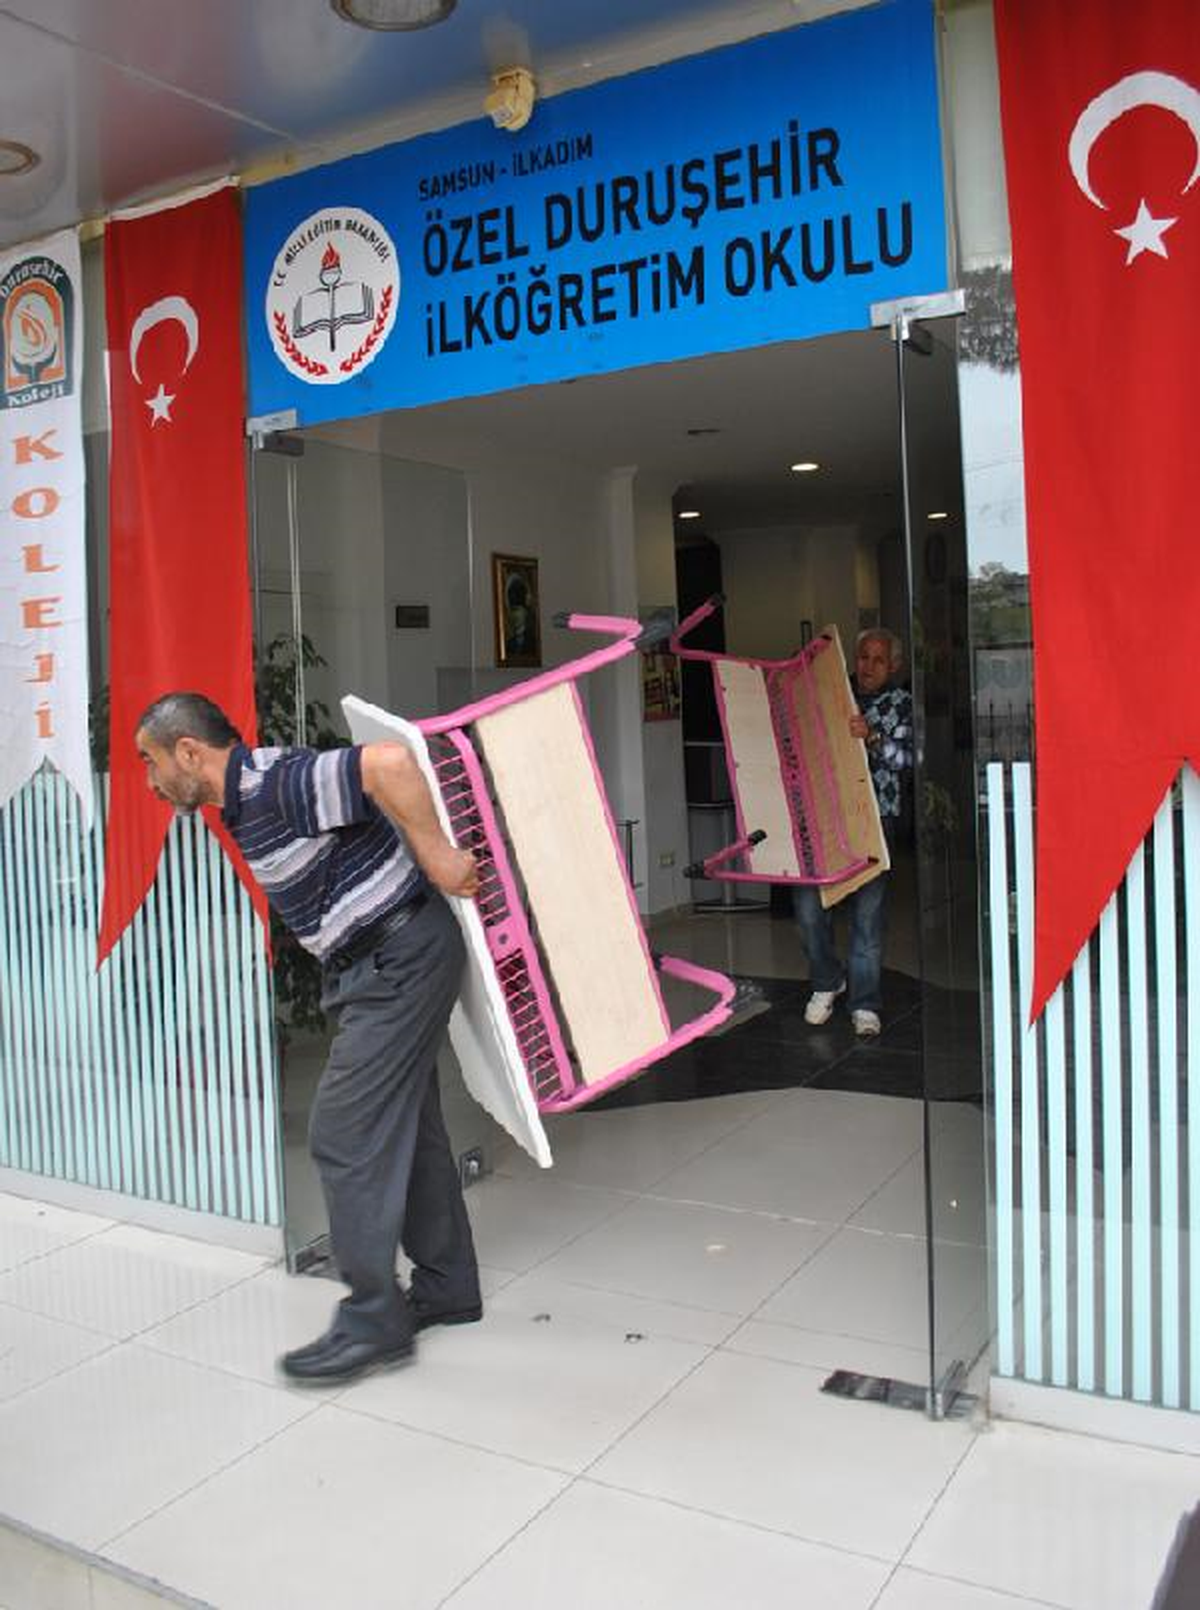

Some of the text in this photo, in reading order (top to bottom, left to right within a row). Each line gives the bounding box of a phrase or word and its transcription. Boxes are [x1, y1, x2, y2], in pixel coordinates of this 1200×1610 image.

[418, 160, 496, 201] SAMSUN
[422, 120, 843, 277] ÖZEL DURUŞEHİR
[724, 202, 915, 298] OKULU
